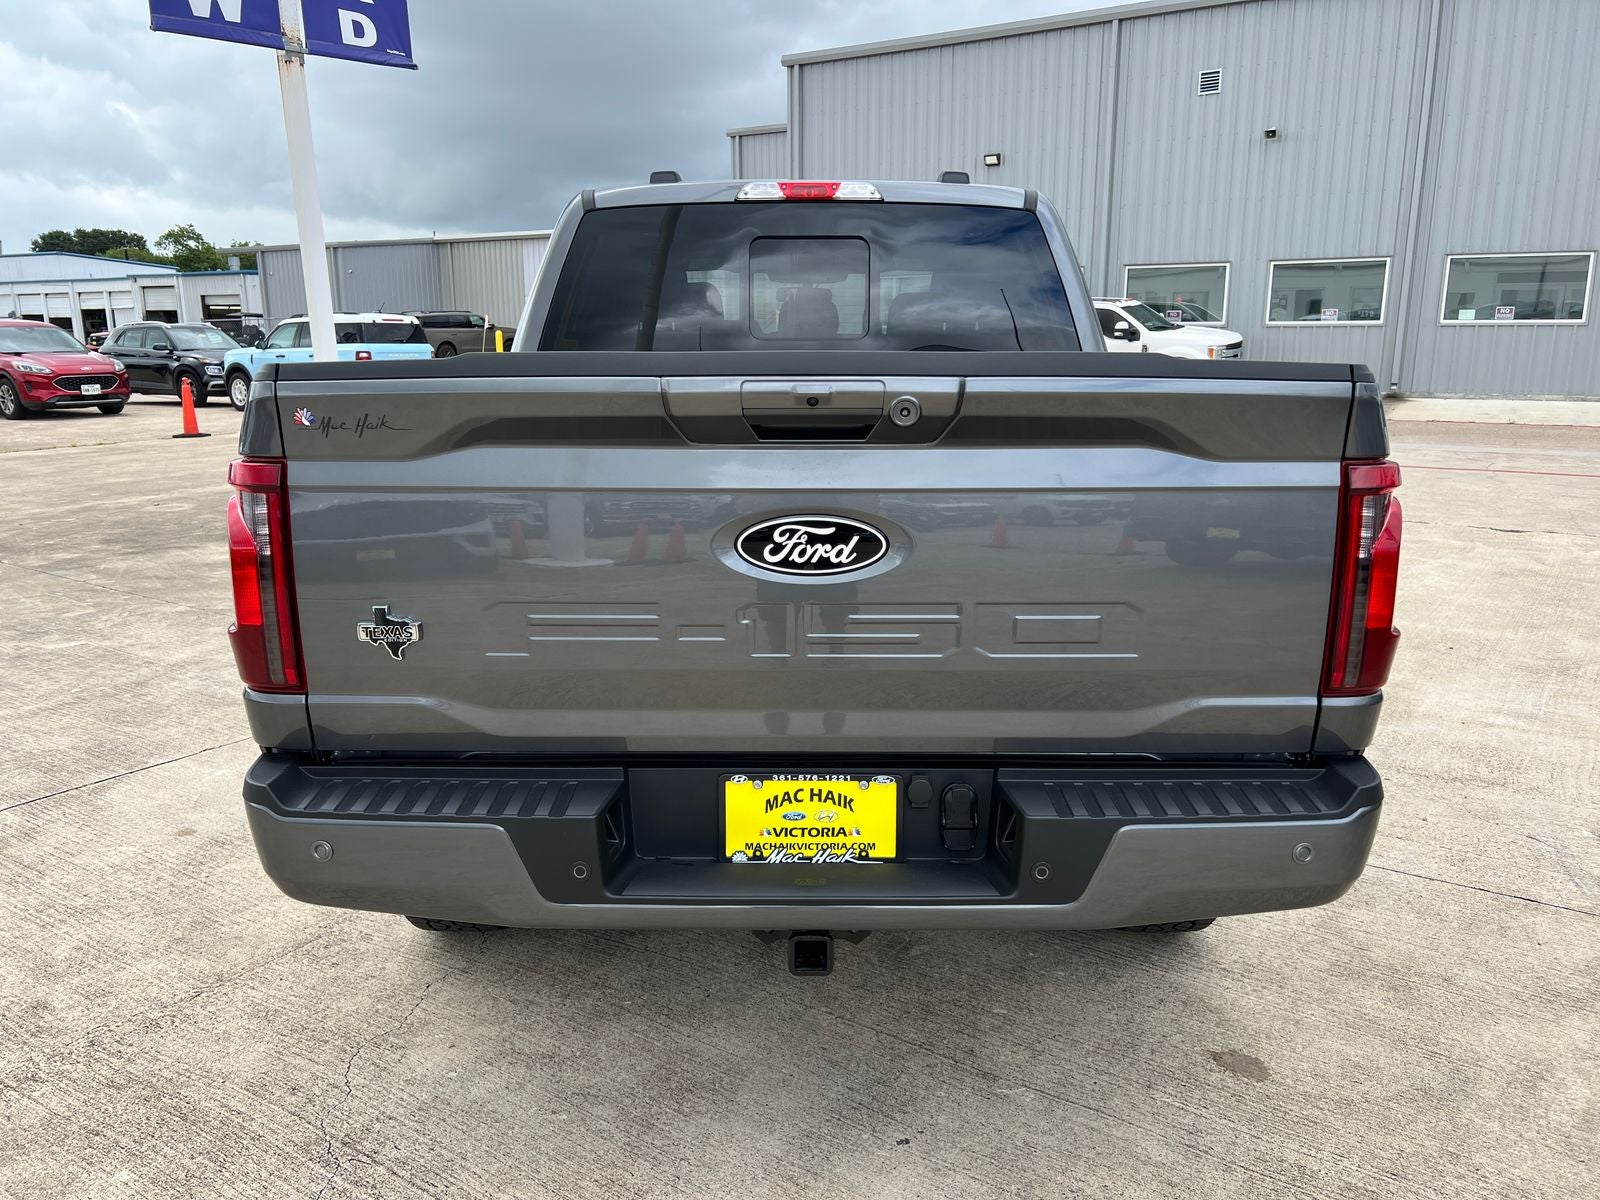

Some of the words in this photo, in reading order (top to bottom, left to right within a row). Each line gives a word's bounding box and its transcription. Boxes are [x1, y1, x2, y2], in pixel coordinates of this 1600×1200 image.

[337, 8, 378, 48] D
[318, 416, 352, 439] Mac
[354, 413, 395, 439] Haik
[763, 525, 860, 564] Ford
[361, 626, 413, 638] TEXAS
[772, 774, 852, 782] 361-576-1221
[764, 788, 805, 814] MAC
[809, 788, 855, 813] HAIK
[773, 827, 848, 838] VICTORIA
[744, 842, 876, 851] MACHAIKVICTORIA.COM
[764, 848, 810, 864] Mac
[811, 848, 862, 864] Haik
